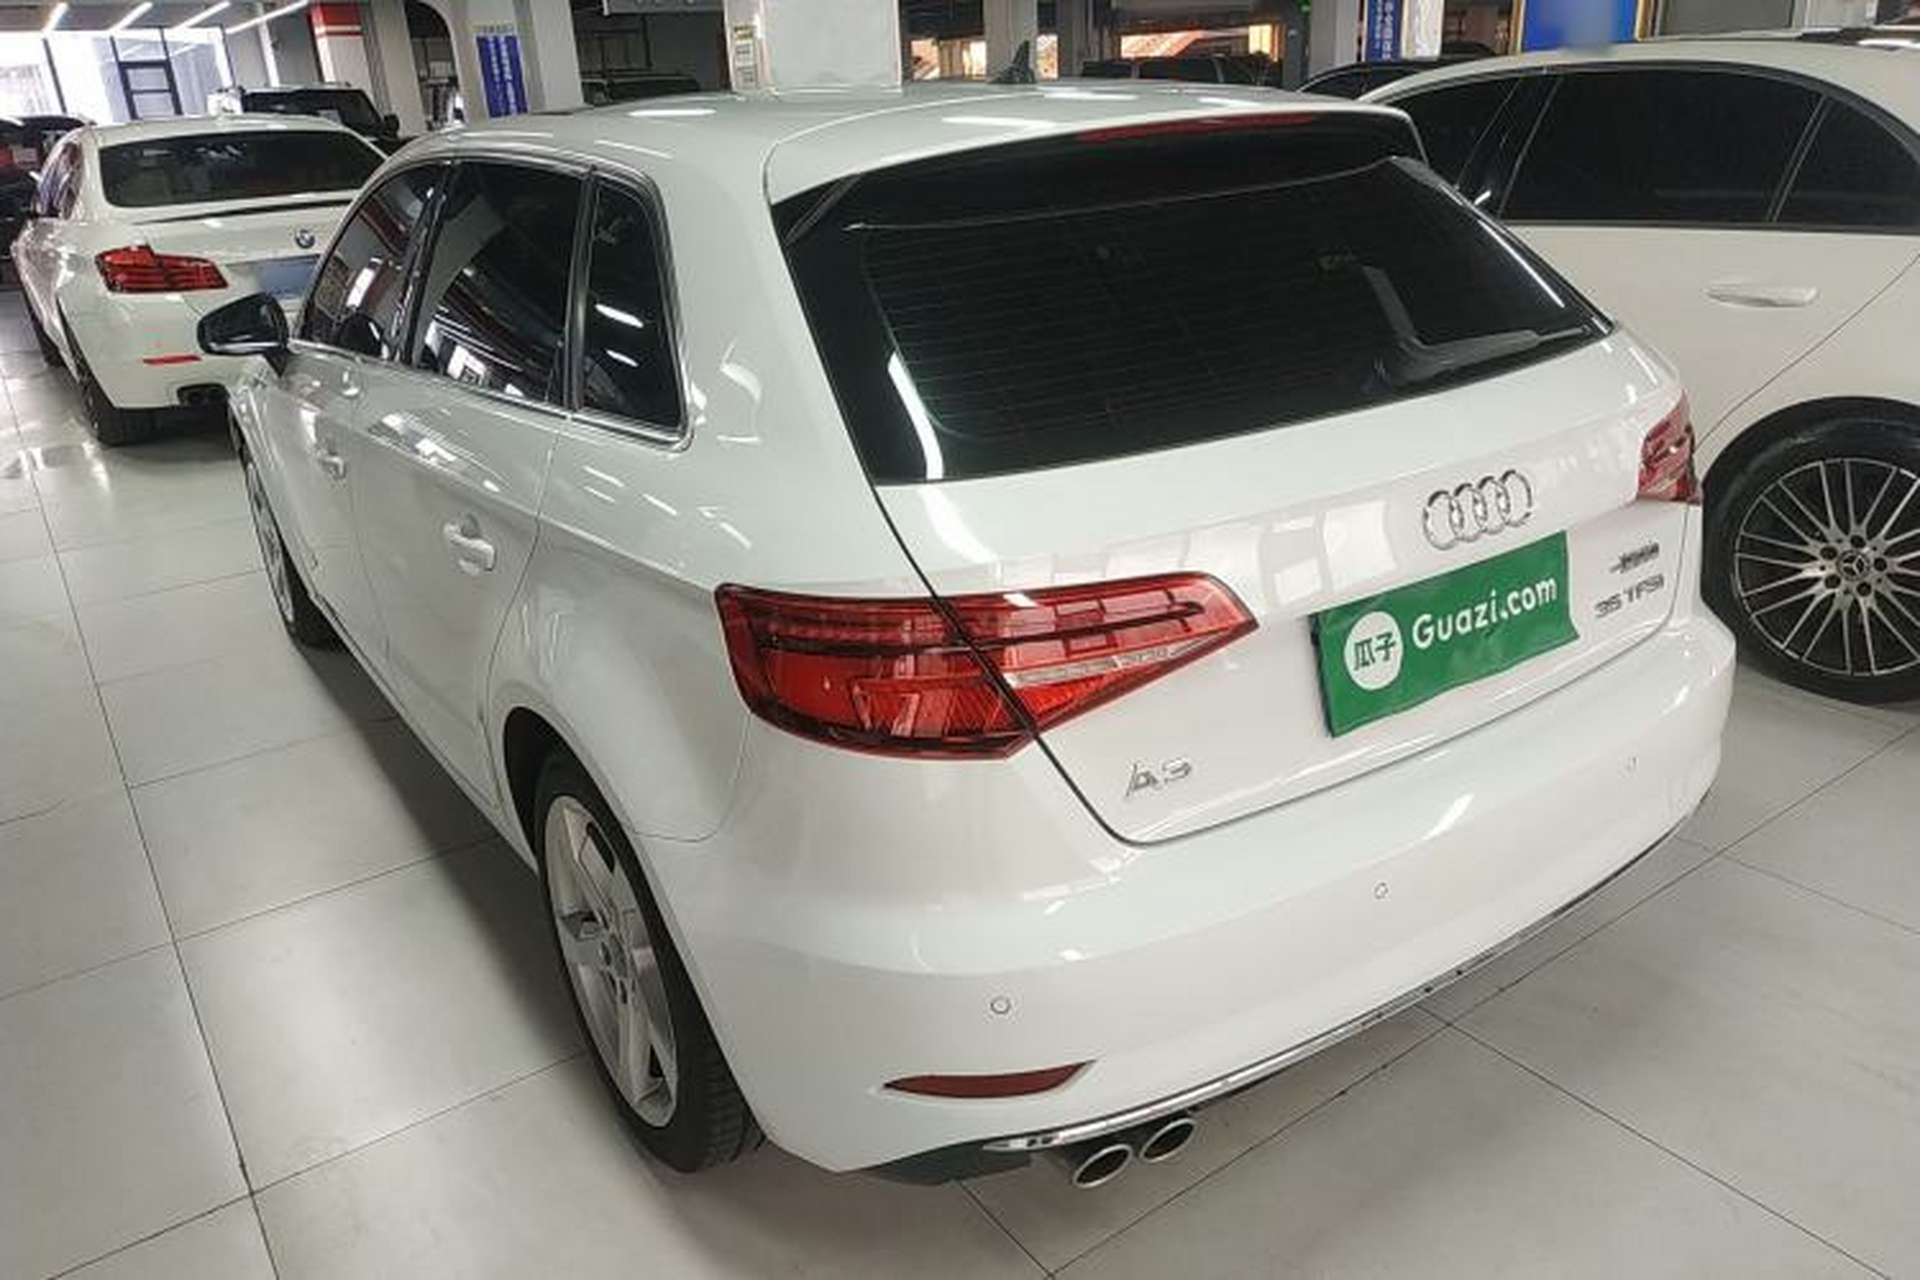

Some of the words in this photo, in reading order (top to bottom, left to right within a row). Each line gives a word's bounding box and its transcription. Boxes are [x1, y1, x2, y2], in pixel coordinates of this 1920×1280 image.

[1412, 577, 1558, 649] Guazi.com
[1594, 593, 1621, 618] 35
[1353, 632, 1396, 671] 瓜子
[1126, 759, 1192, 797] A3
